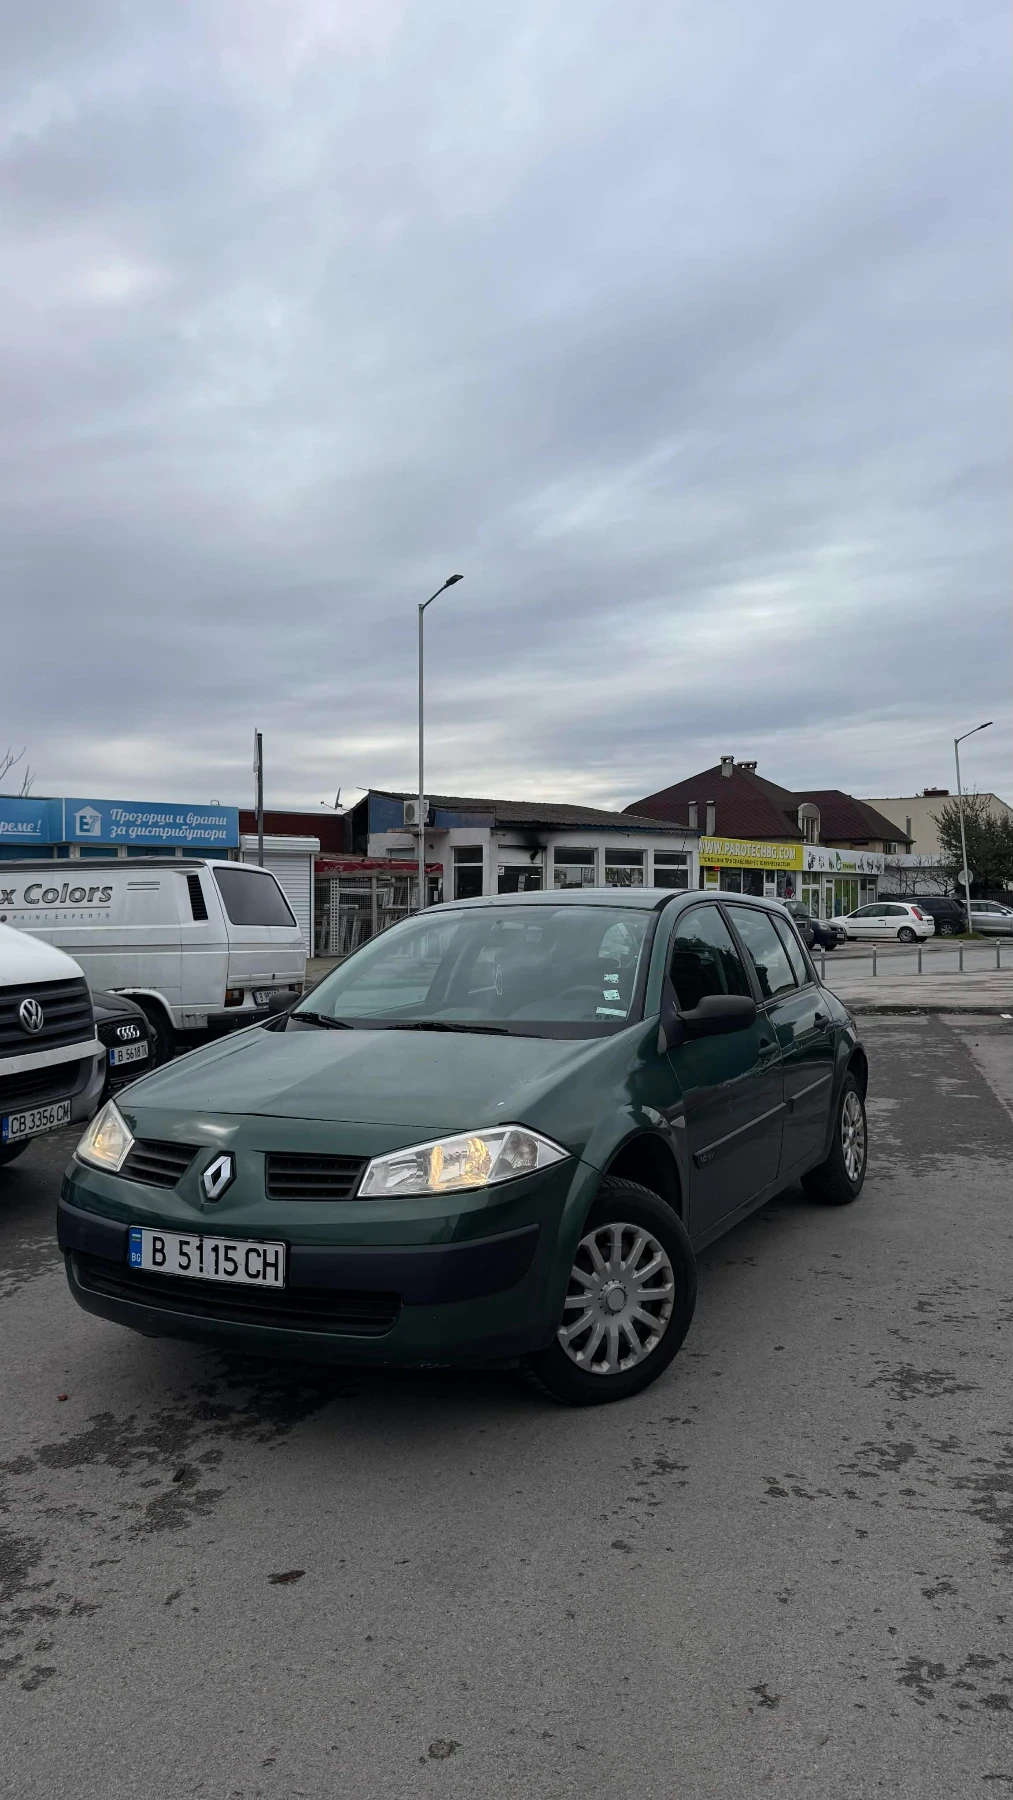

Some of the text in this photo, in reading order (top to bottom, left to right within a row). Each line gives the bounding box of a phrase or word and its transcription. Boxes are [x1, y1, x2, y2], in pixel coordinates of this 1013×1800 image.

[110, 809, 227, 827] Прозорци и врати
[110, 826, 227, 841] за дистрибутори
[23, 882, 113, 904] Colors
[54, 912, 110, 920] EXPERTS
[117, 1050, 124, 1062] B
[11, 1115, 26, 1134] CB
[29, 1107, 55, 1130] 3356
[57, 1102, 70, 1121] CM
[131, 1252, 141, 1262] BG
[152, 1235, 279, 1281] B 5115 CH
